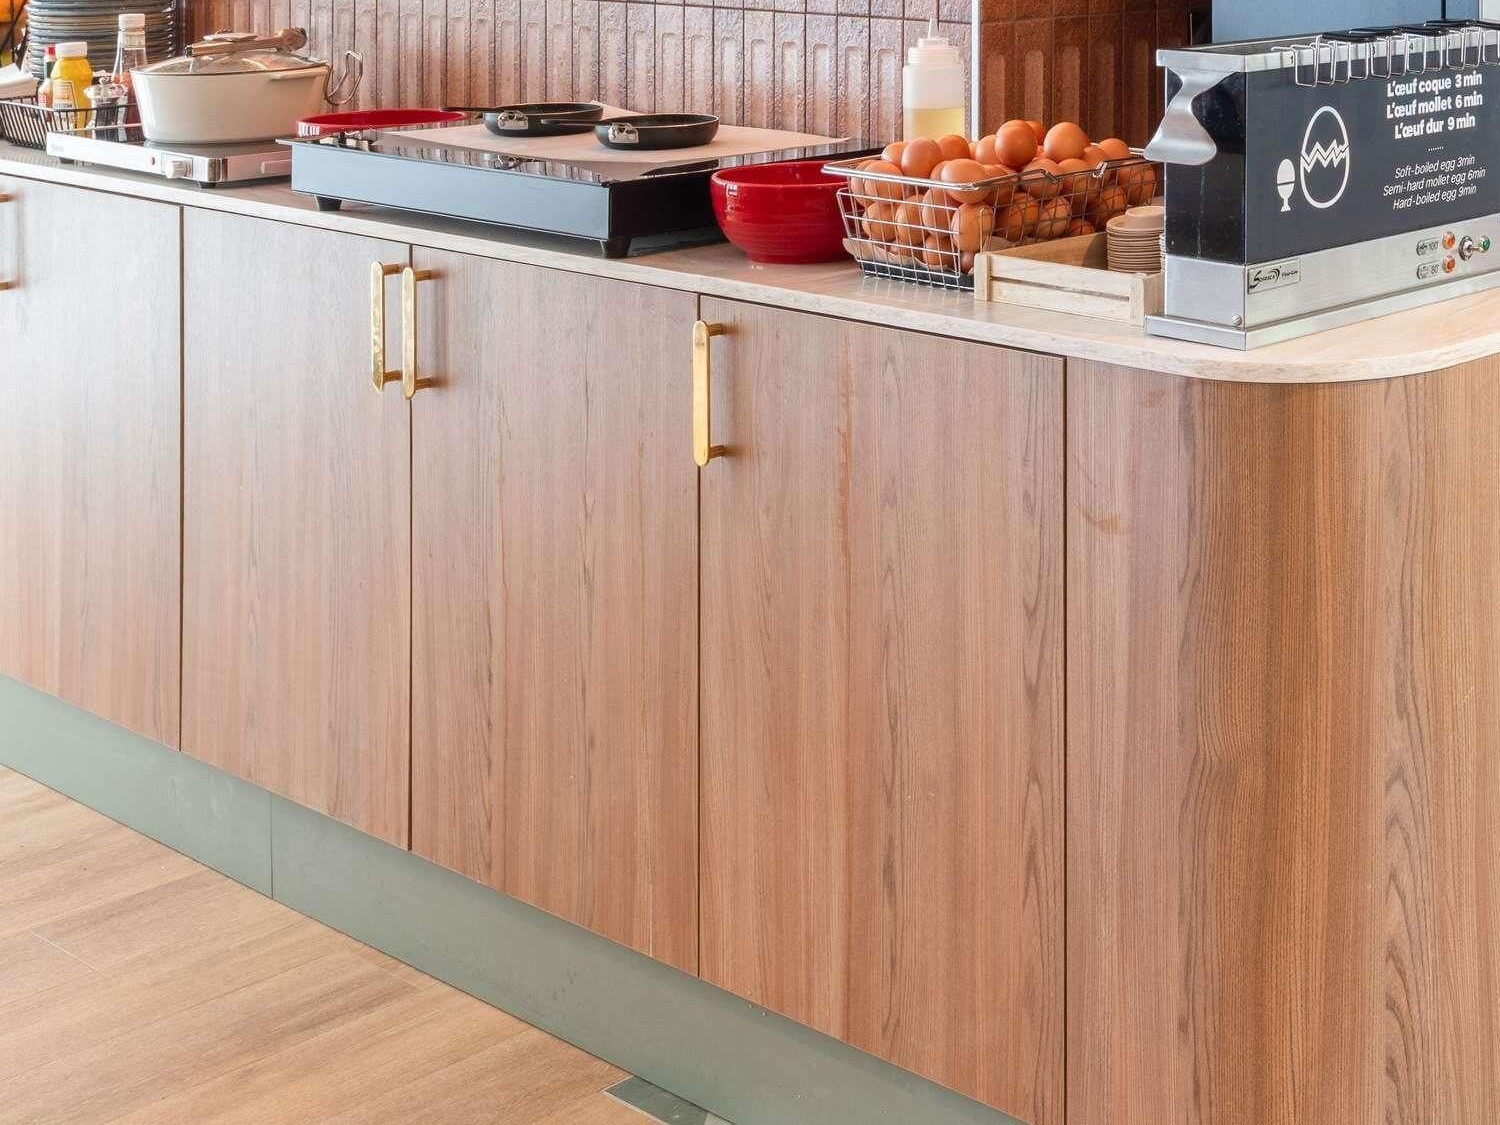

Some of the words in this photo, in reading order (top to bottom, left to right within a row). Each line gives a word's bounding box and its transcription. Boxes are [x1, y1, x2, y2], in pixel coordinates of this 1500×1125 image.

[1419, 78, 1451, 94] coque
[1455, 74, 1462, 87] 3
[1463, 70, 1482, 86] min
[1418, 96, 1452, 114] mollet
[1455, 94, 1462, 108] 6
[1464, 91, 1483, 107] min
[1426, 118, 1444, 134] dur
[1448, 116, 1454, 130] 9
[1456, 112, 1475, 130] min
[1395, 160, 1439, 179] Soft-boiled
[1440, 159, 1456, 171] egg
[1457, 155, 1475, 168] 3min
[1383, 178, 1424, 196] Semi-hard
[1425, 174, 1450, 189] mollet
[1451, 172, 1465, 185] egg
[1393, 190, 1440, 211] Hard-boiled
[1441, 188, 1457, 201] egg
